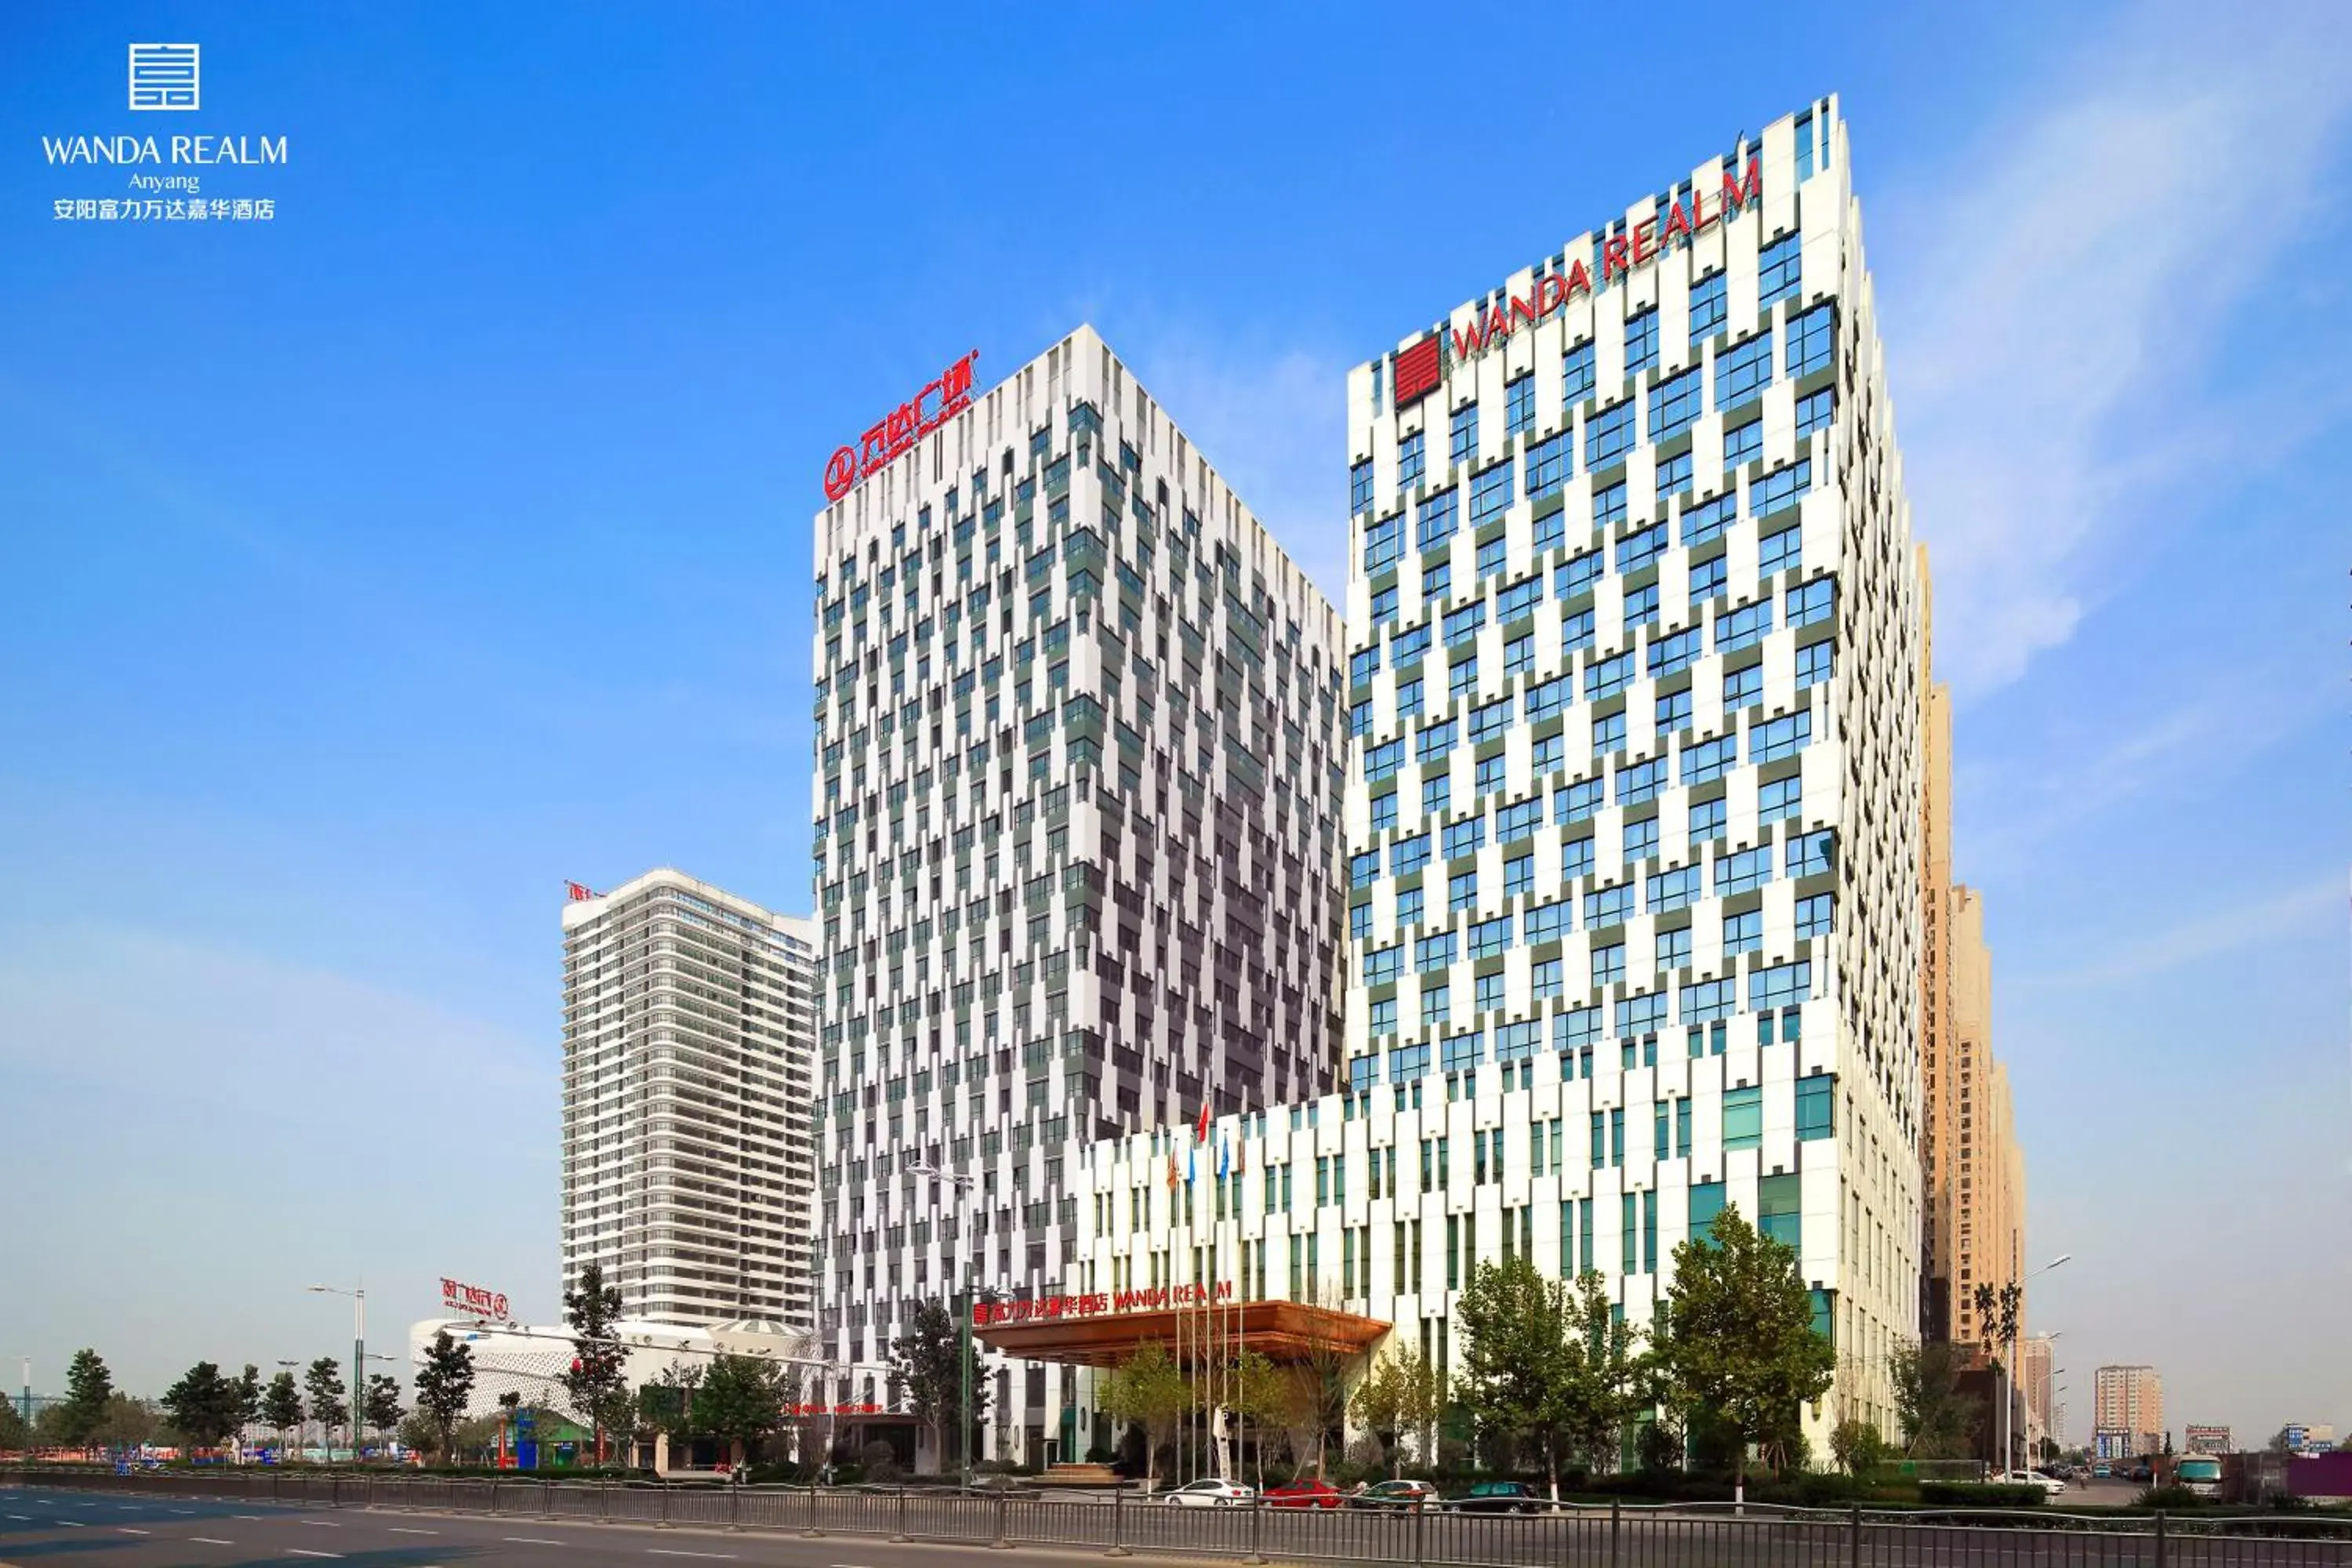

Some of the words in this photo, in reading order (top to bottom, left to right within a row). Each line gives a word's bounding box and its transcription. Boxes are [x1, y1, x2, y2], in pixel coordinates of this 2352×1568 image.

[1454, 258, 1592, 361] WANDA
[1602, 156, 1760, 281] REALM
[1113, 1285, 1167, 1309] WANDA
[1173, 1279, 1232, 1303] REAM
